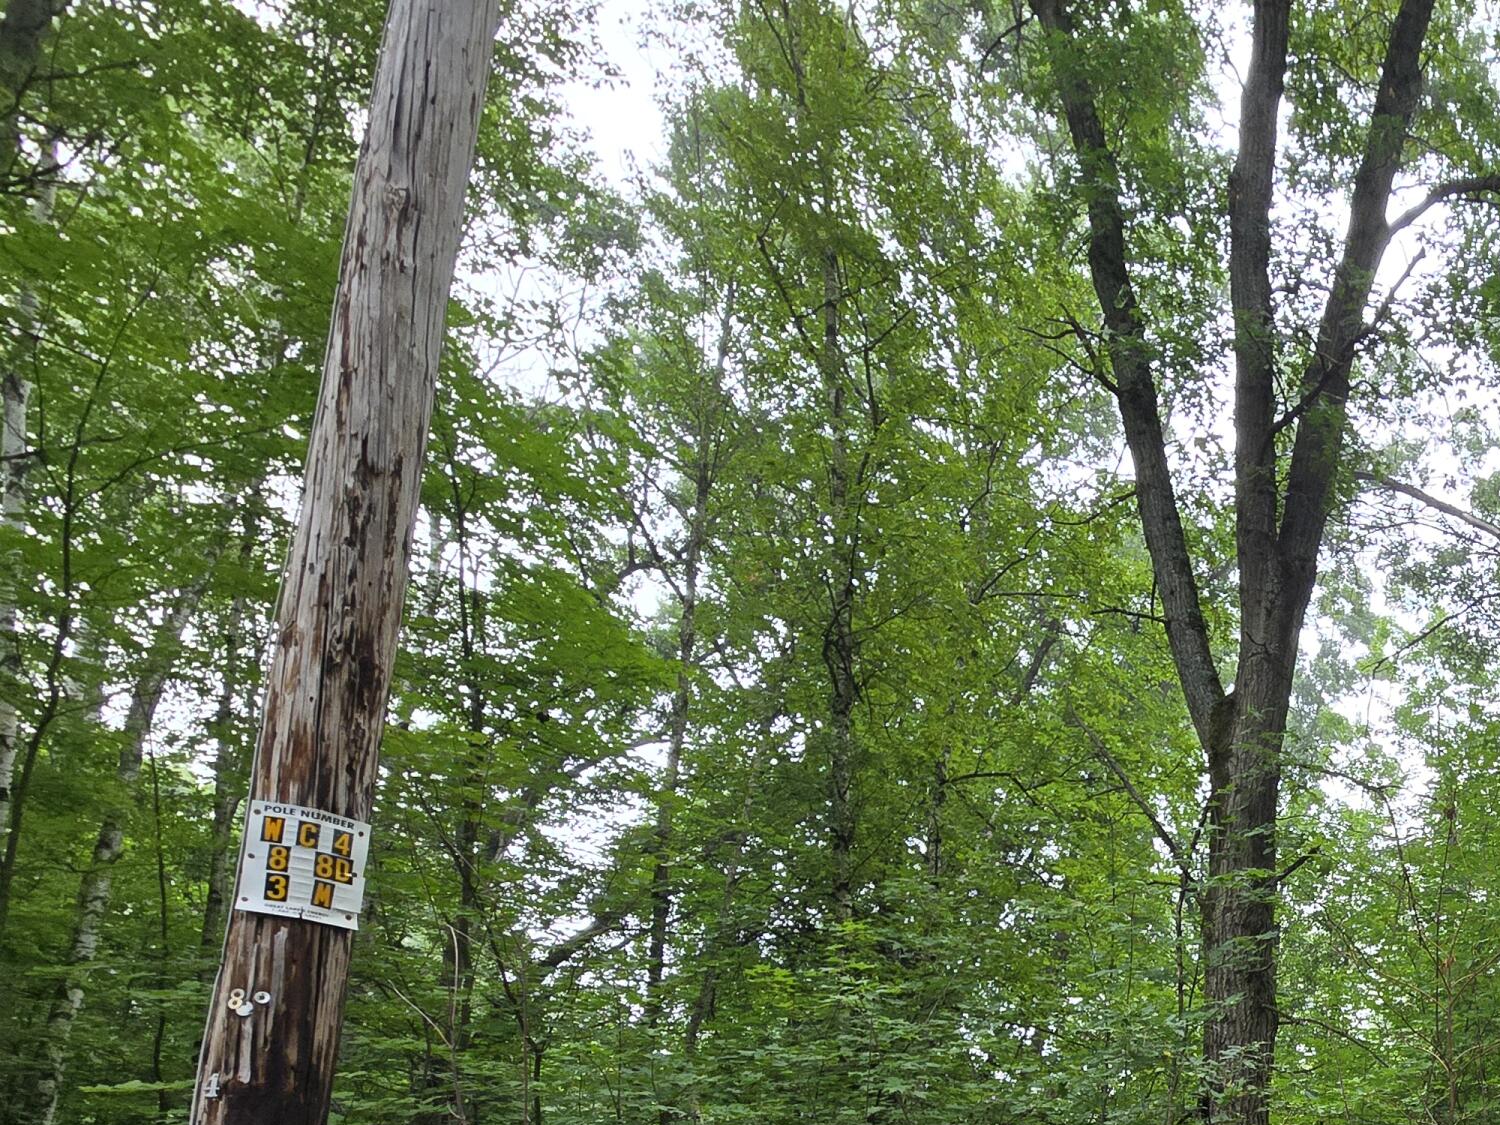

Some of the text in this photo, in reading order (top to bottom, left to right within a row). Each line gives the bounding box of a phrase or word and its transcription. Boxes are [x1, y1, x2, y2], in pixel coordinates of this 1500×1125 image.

[263, 804, 356, 831] POLE NUMBER
[263, 816, 351, 856] W C 4
[268, 846, 289, 870] 8
[266, 874, 332, 908] 3 M
